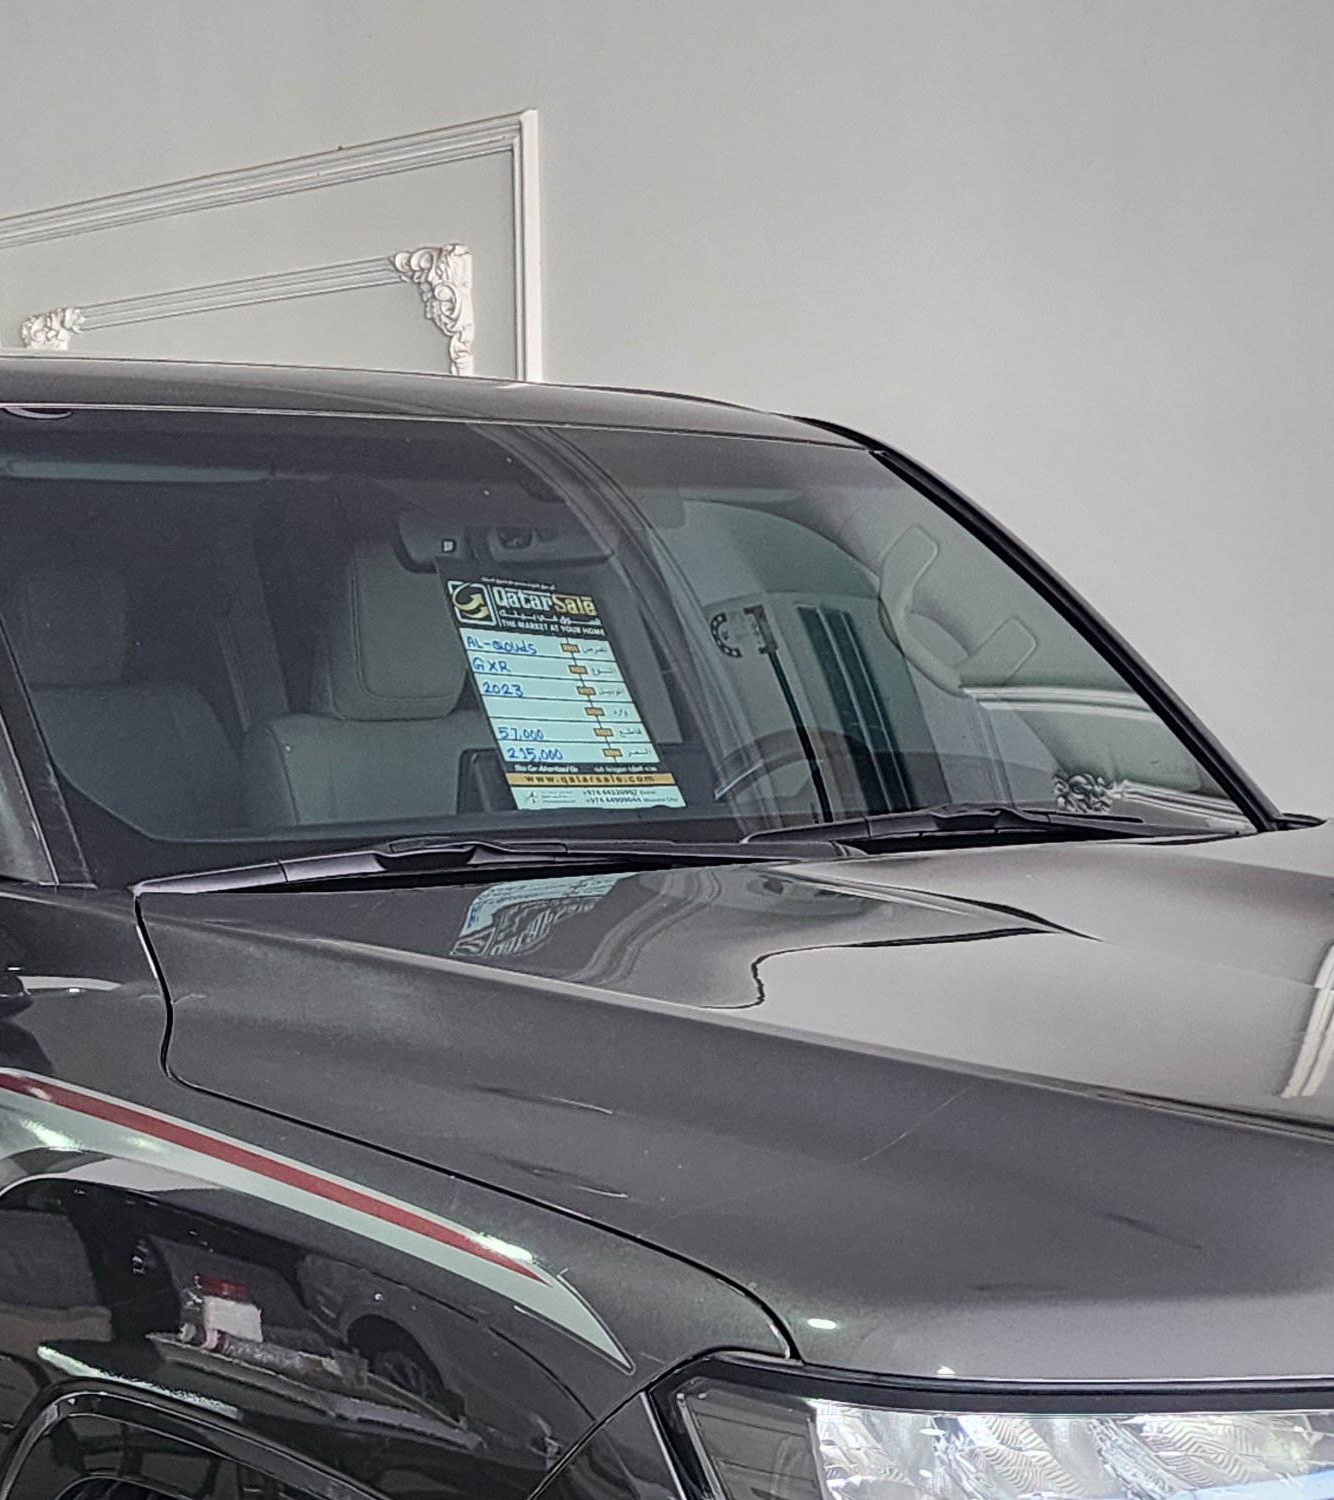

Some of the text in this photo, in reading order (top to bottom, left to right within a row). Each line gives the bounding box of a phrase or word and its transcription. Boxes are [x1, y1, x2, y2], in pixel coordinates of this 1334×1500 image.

[492, 586, 598, 616] QatarSale
[501, 619, 606, 636] THE MARKET AT YOUR HOME
[482, 682, 524, 697] 2023
